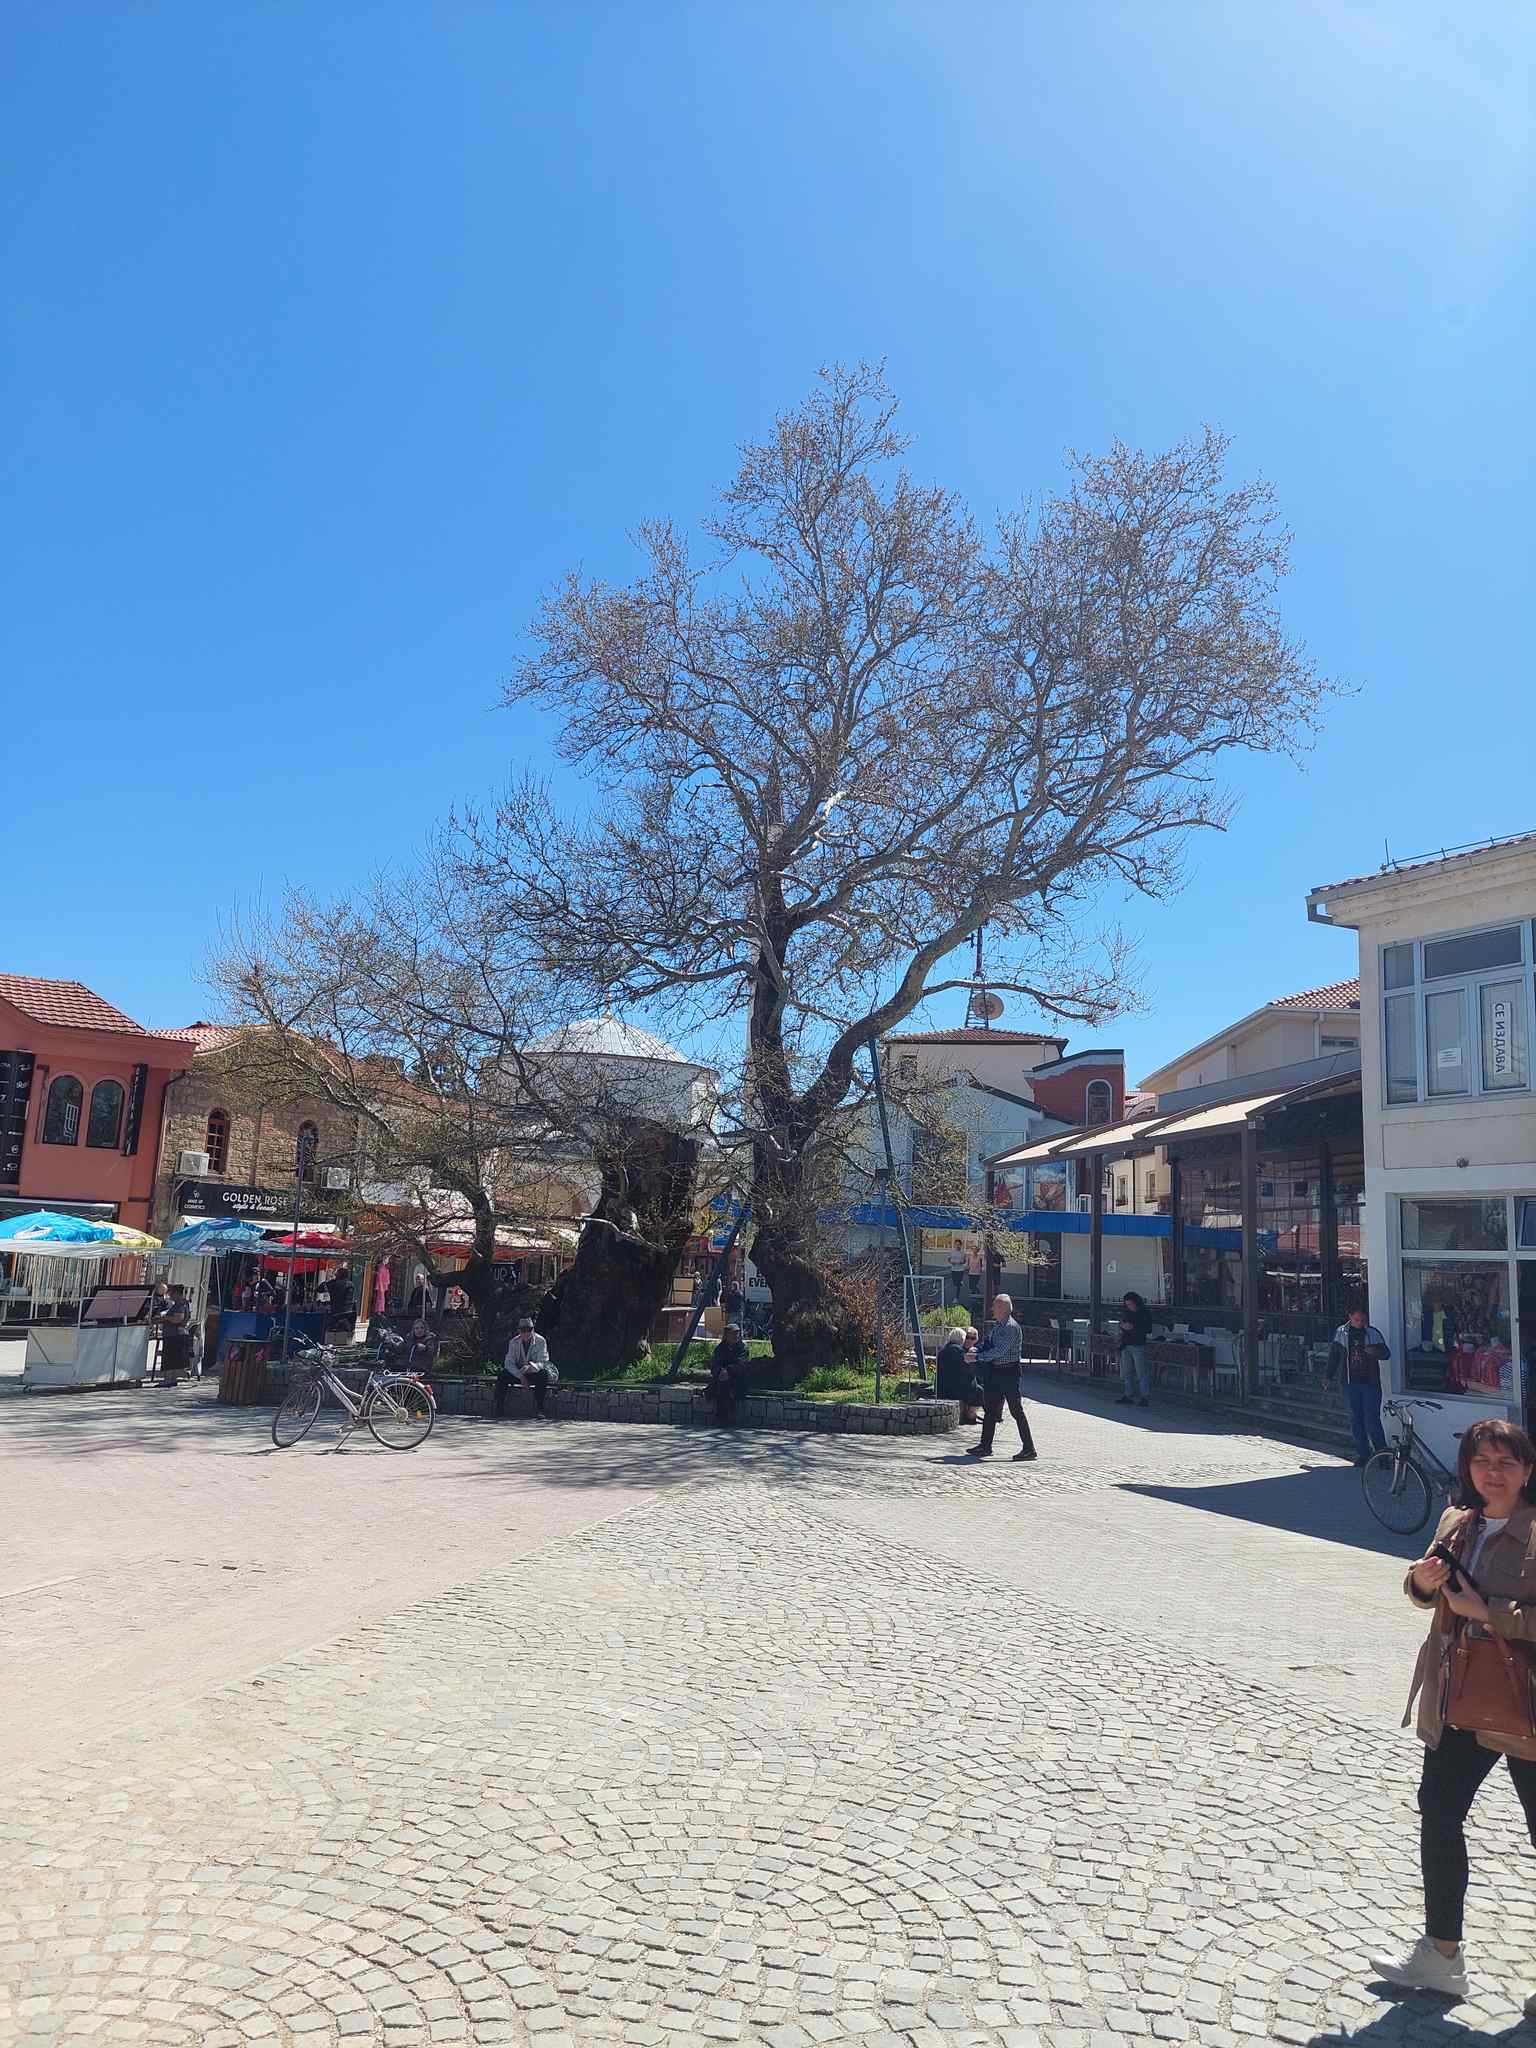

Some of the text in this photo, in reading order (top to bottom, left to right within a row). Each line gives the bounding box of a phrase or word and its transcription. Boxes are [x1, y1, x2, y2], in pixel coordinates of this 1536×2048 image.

[1494, 1003, 1506, 1073] СЕ ИЗДАВА
[222, 1192, 289, 1206] GOLDEN ROSE
